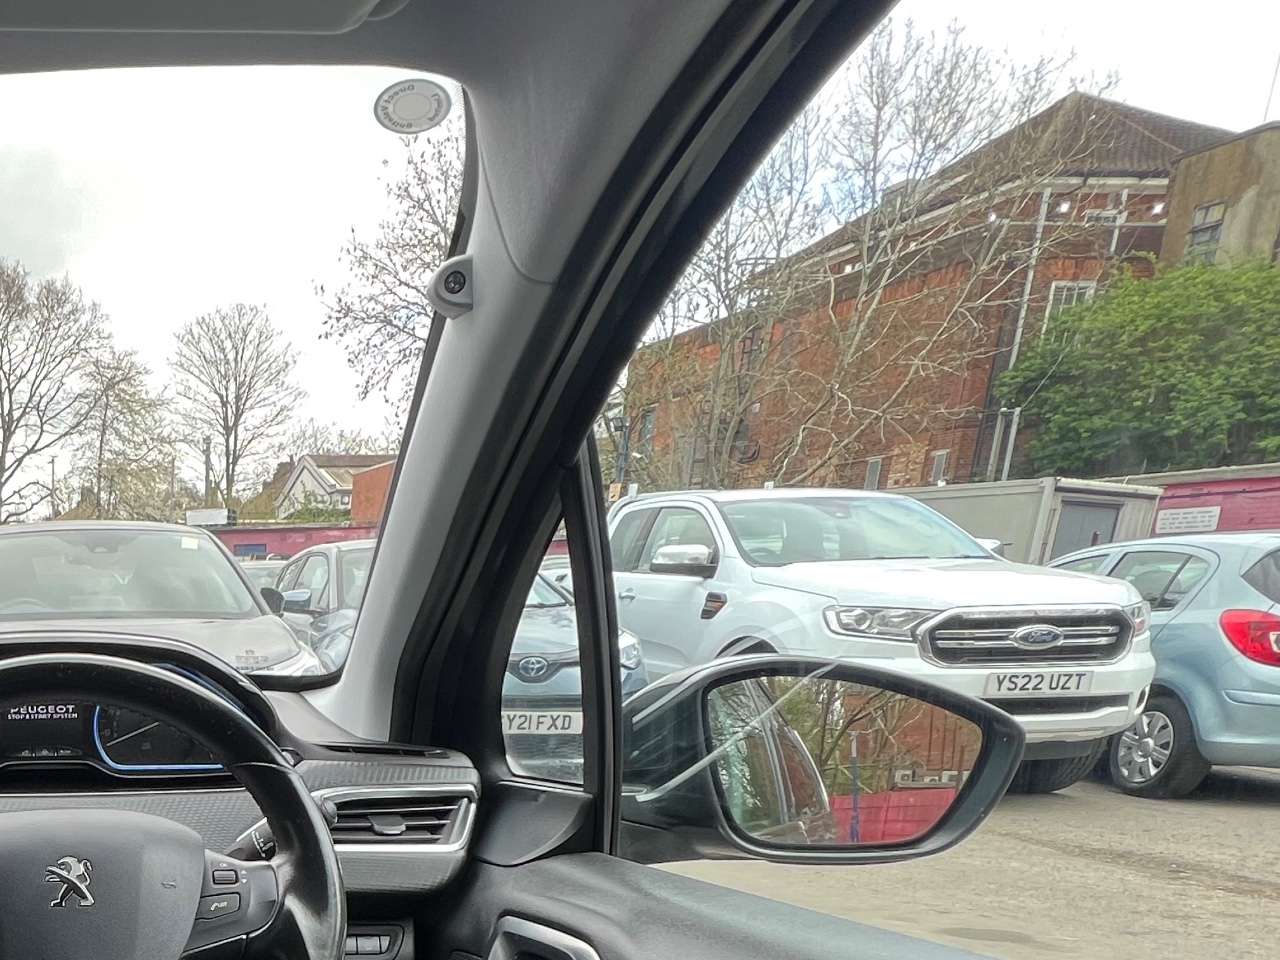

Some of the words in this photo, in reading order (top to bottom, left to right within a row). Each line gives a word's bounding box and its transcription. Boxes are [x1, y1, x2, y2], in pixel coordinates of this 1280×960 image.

[1027, 629, 1056, 643] Ford
[996, 674, 1044, 692] YS22
[1049, 673, 1087, 691] UZT
[10, 704, 76, 714] PEUGEOT
[503, 714, 532, 731] Y21
[535, 714, 572, 731] FXD
